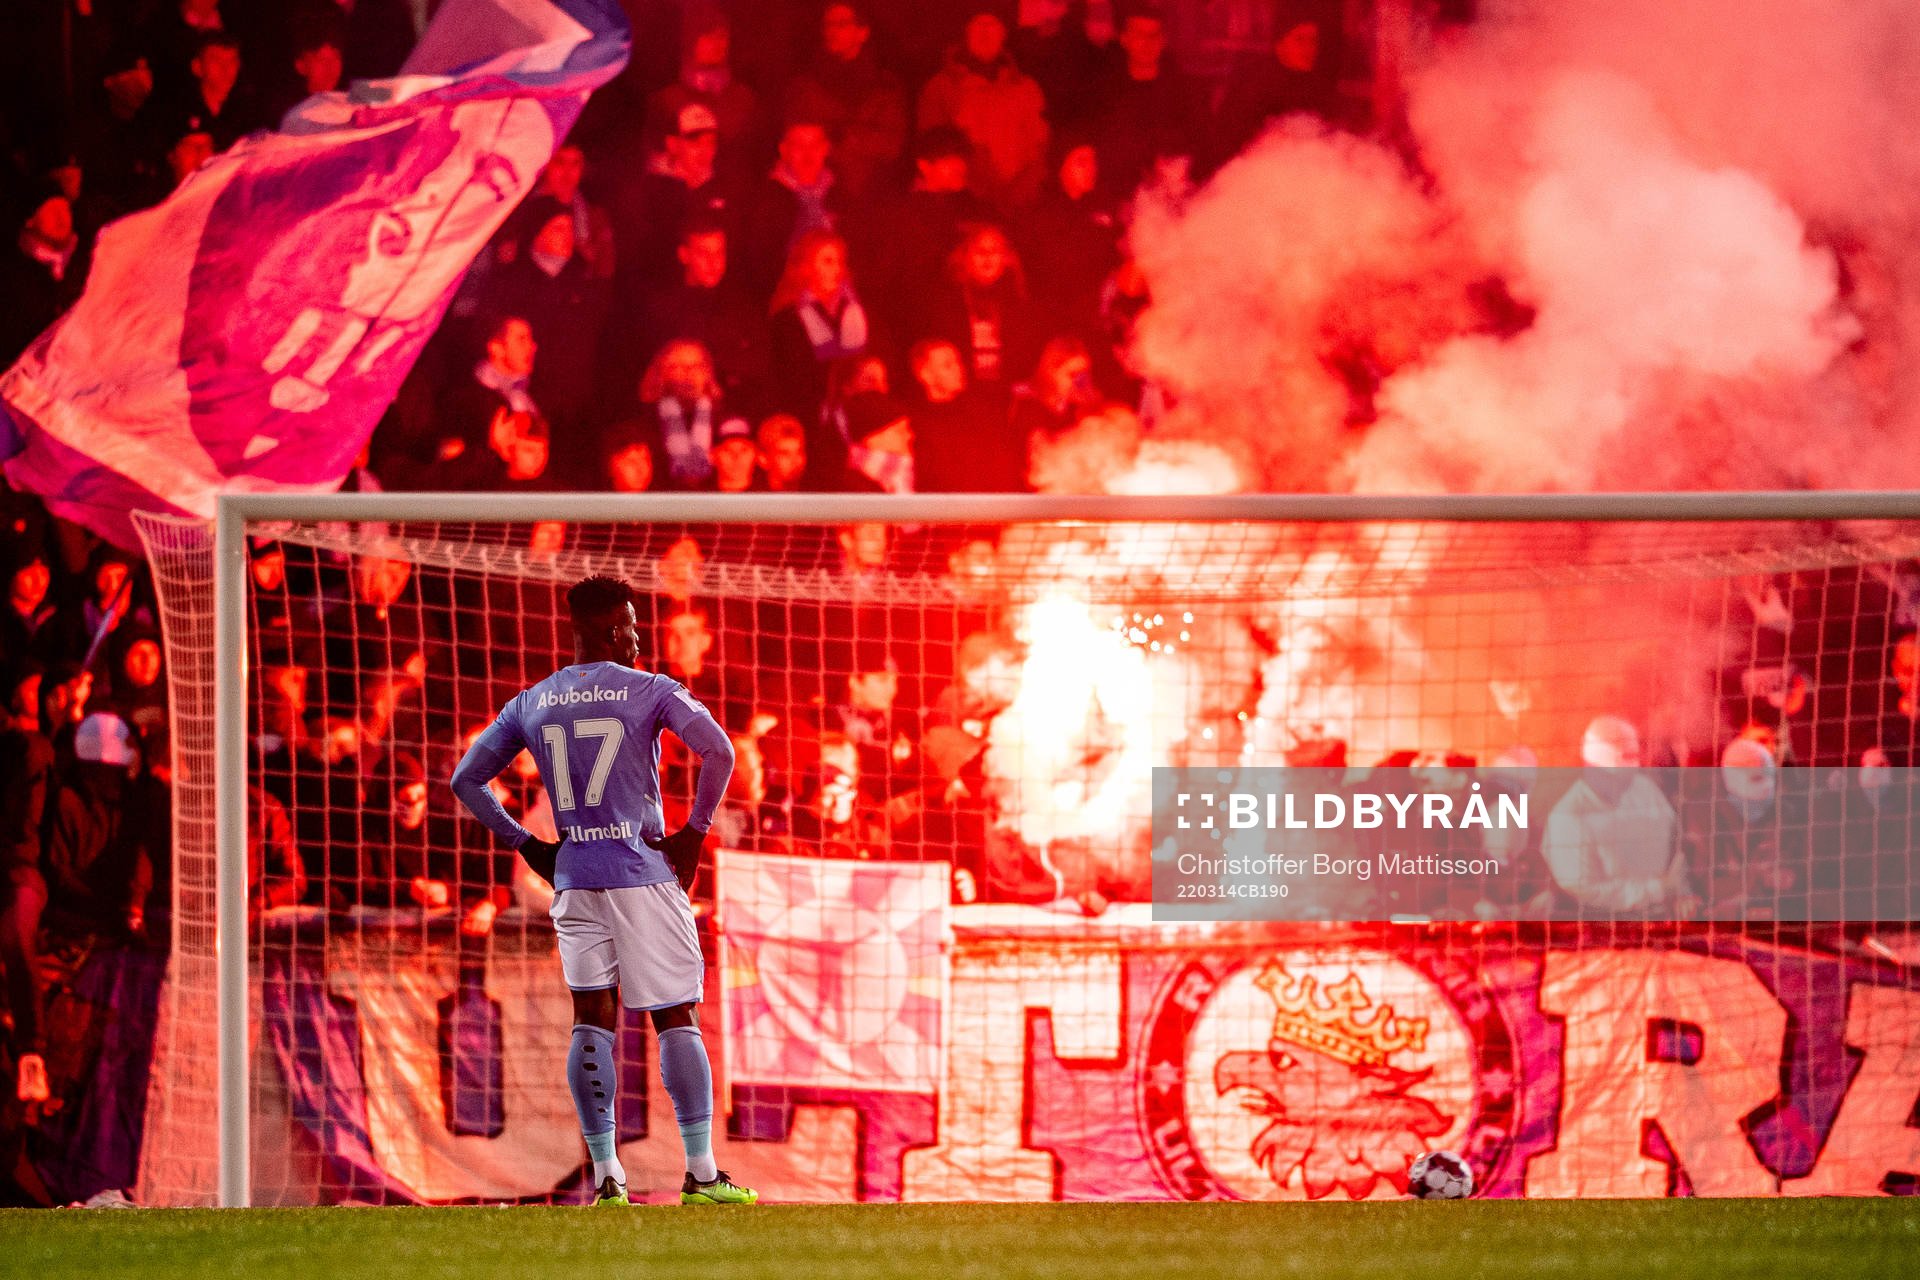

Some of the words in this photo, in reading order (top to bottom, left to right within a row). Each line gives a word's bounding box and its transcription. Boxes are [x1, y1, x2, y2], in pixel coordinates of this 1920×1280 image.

[536, 684, 629, 710] Abubakari
[541, 717, 625, 812] 17
[561, 821, 633, 843] llmobil
